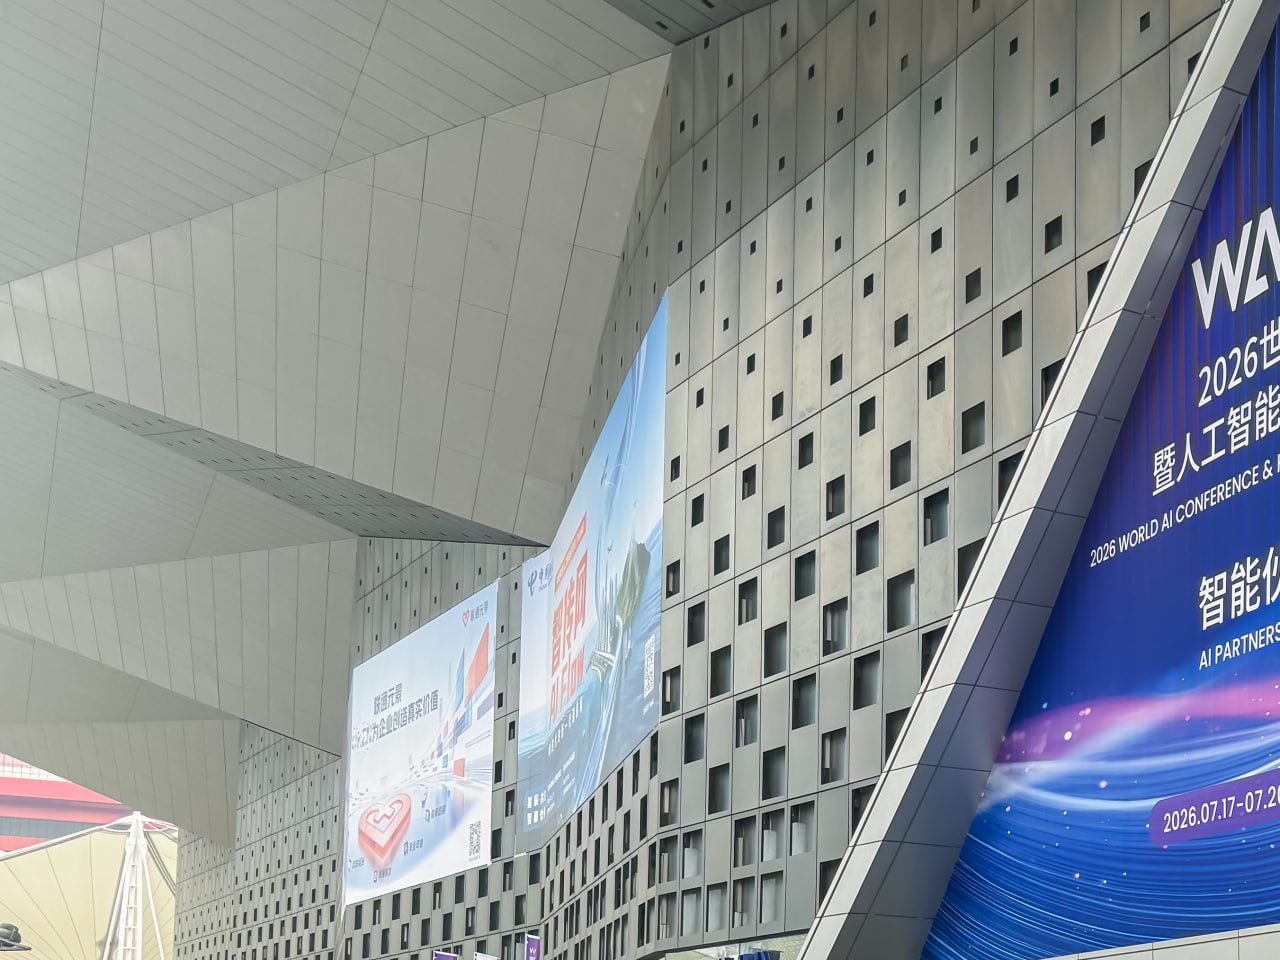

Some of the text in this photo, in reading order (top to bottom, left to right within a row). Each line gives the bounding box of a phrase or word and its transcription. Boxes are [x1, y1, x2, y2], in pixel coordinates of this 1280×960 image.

[1089, 540, 1117, 568] 2026
[1117, 517, 1159, 553] WORLD
[1161, 509, 1175, 532] AI
[1175, 472, 1260, 525] CONFERENCE
[1262, 460, 1274, 480] &
[1199, 648, 1213, 670] AI
